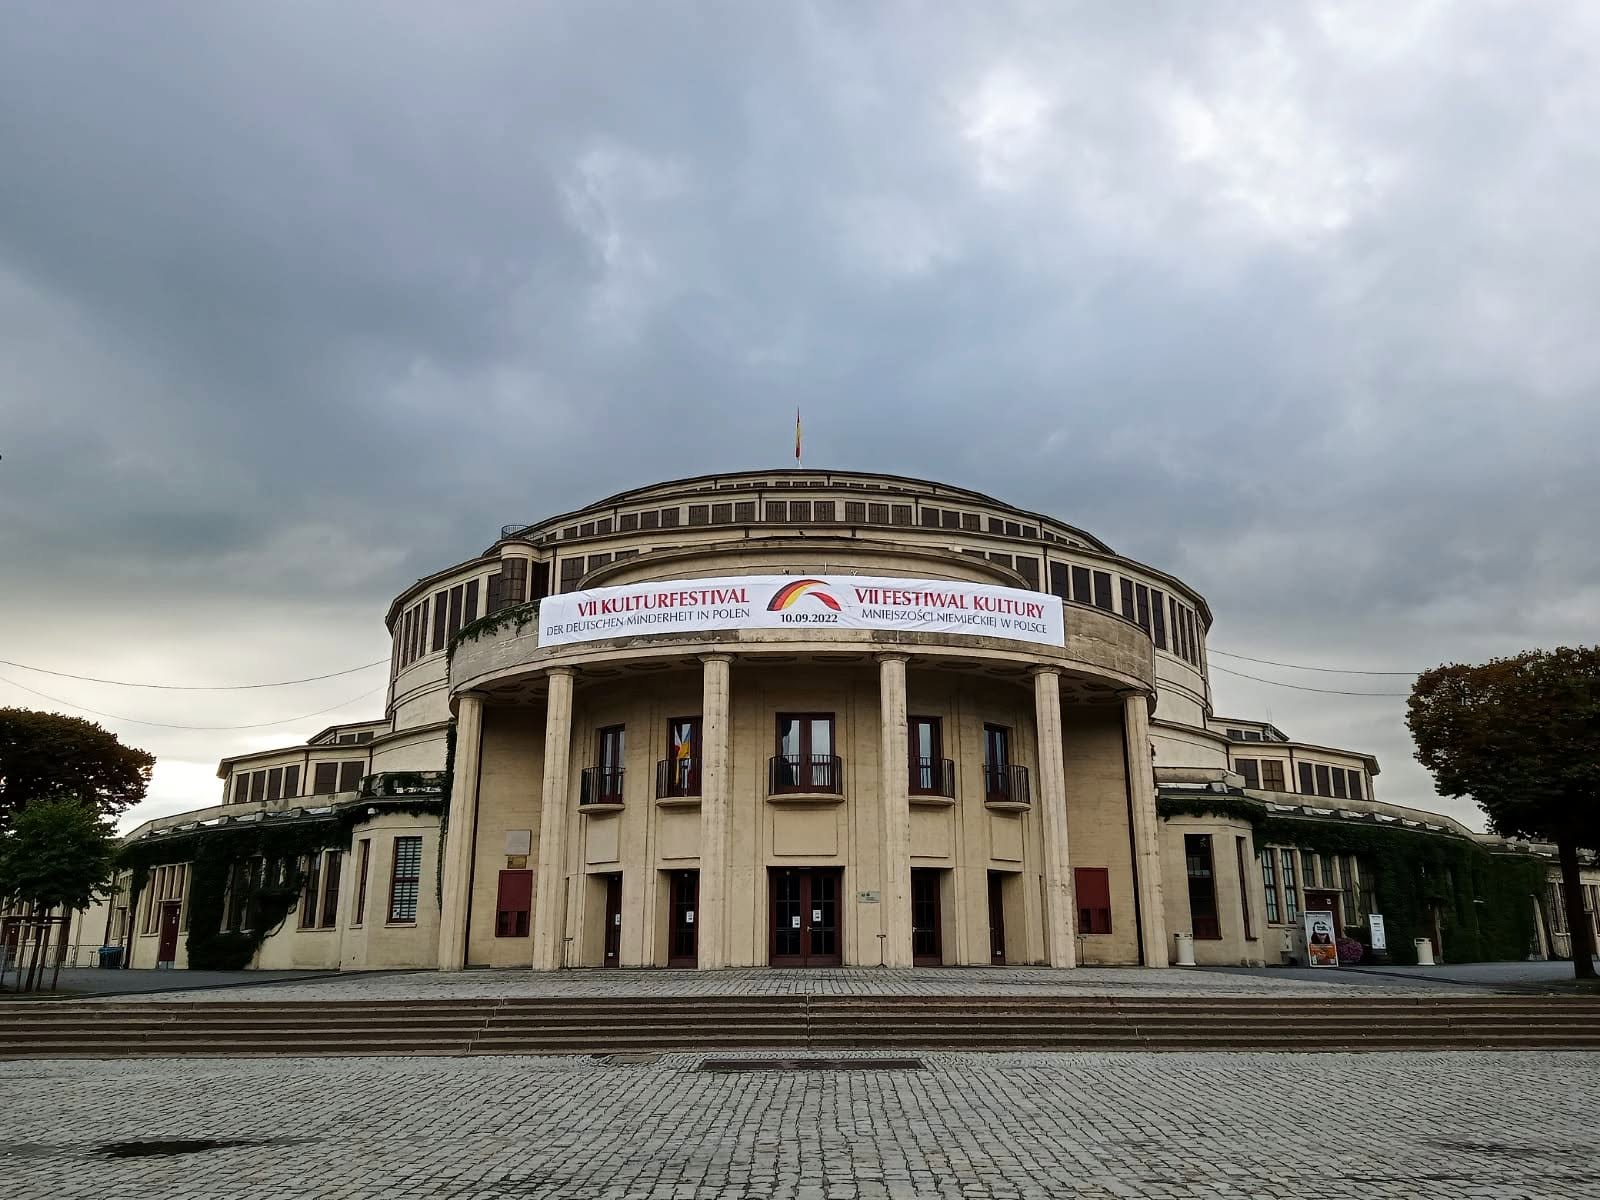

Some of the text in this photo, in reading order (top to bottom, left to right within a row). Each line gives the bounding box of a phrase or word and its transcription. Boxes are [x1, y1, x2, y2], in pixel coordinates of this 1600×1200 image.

[578, 588, 750, 617] VII KULTURFESTIVAL
[855, 588, 1044, 619] VII FESTIWAL KULTURY
[546, 608, 750, 636] DER DEUTSCHEN MINDERHEIT IN POLEN
[780, 613, 838, 623] 10.09.2022
[861, 608, 1047, 633] MNIEJSZOŚCI NIEMIECKIEJ W POLSCE
